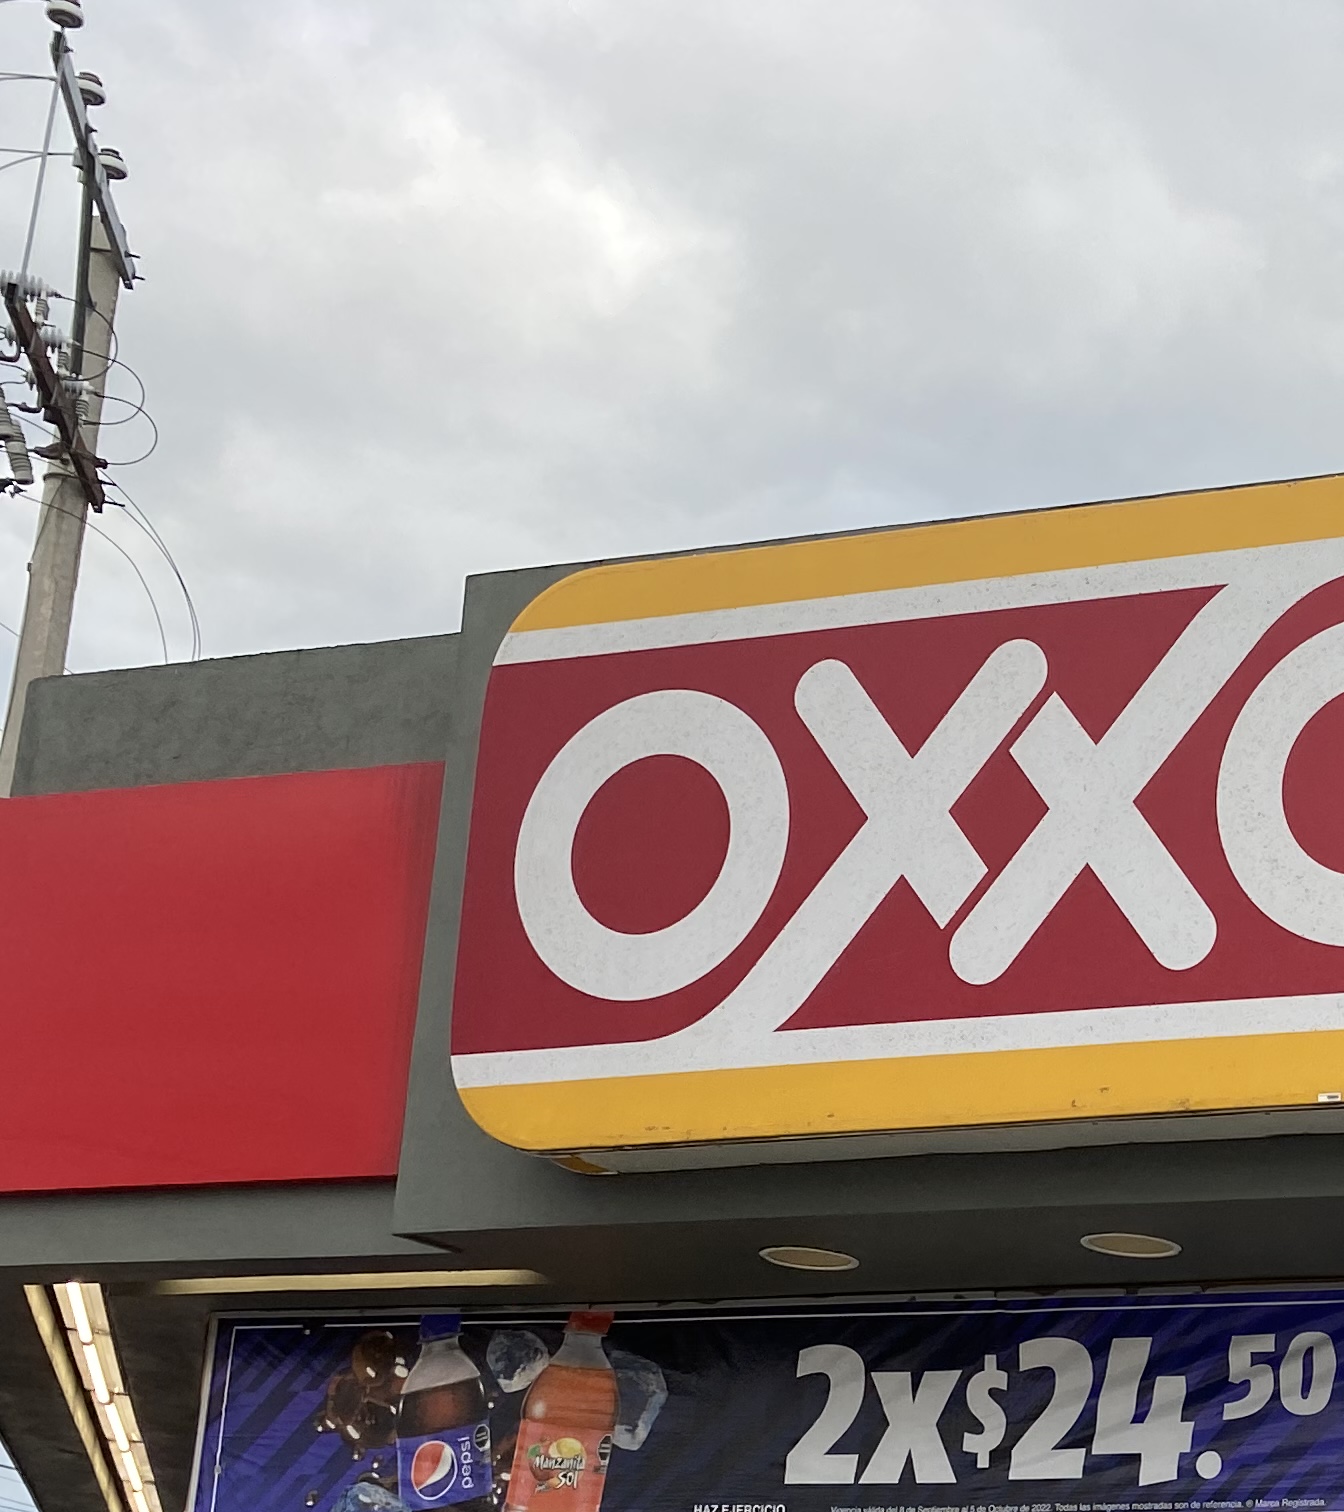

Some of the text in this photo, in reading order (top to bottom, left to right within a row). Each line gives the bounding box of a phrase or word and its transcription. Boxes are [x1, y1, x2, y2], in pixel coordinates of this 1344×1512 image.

[457, 1436, 475, 1490] pepsi
[533, 1454, 586, 1471] Manzanita
[1055, 1502, 1078, 1512] Todas
[1092, 1501, 1130, 1512] imágenes
[1132, 1501, 1173, 1511] mostradas
